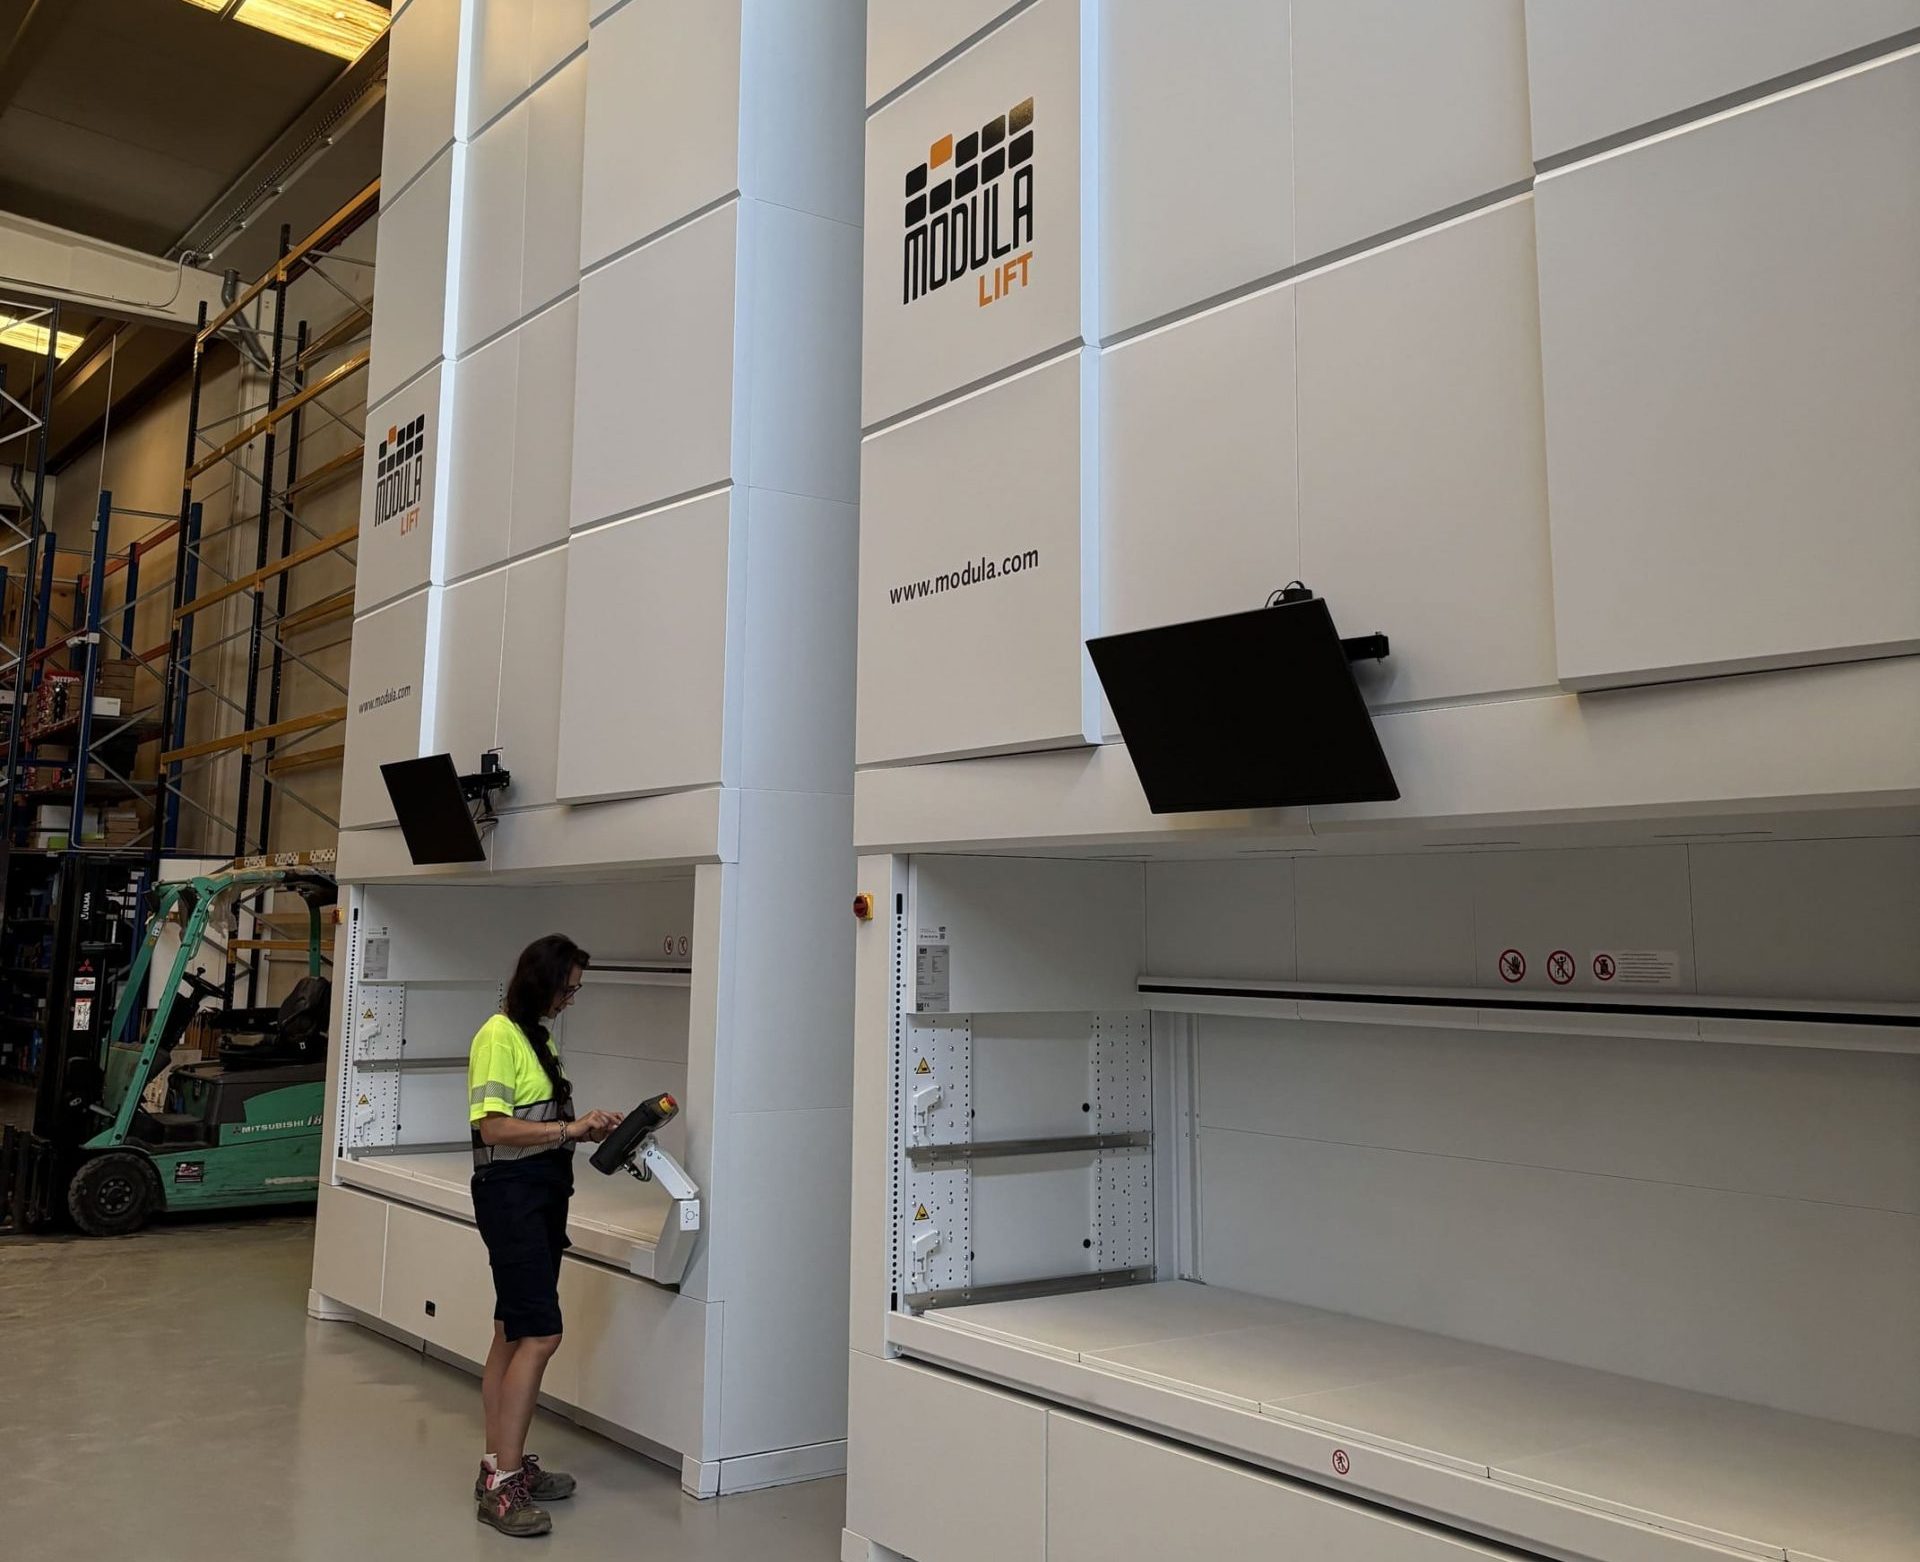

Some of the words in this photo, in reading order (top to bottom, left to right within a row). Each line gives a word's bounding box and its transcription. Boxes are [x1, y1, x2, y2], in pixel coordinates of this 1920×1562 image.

[903, 163, 1033, 305] MODULA
[979, 251, 1033, 308] LIFT
[374, 454, 423, 527] MODULA
[400, 507, 421, 536] LIFT
[889, 549, 1039, 604] www.modula.com
[358, 685, 411, 714] www.modula.com
[241, 1120, 304, 1134] MITSUBISHI
